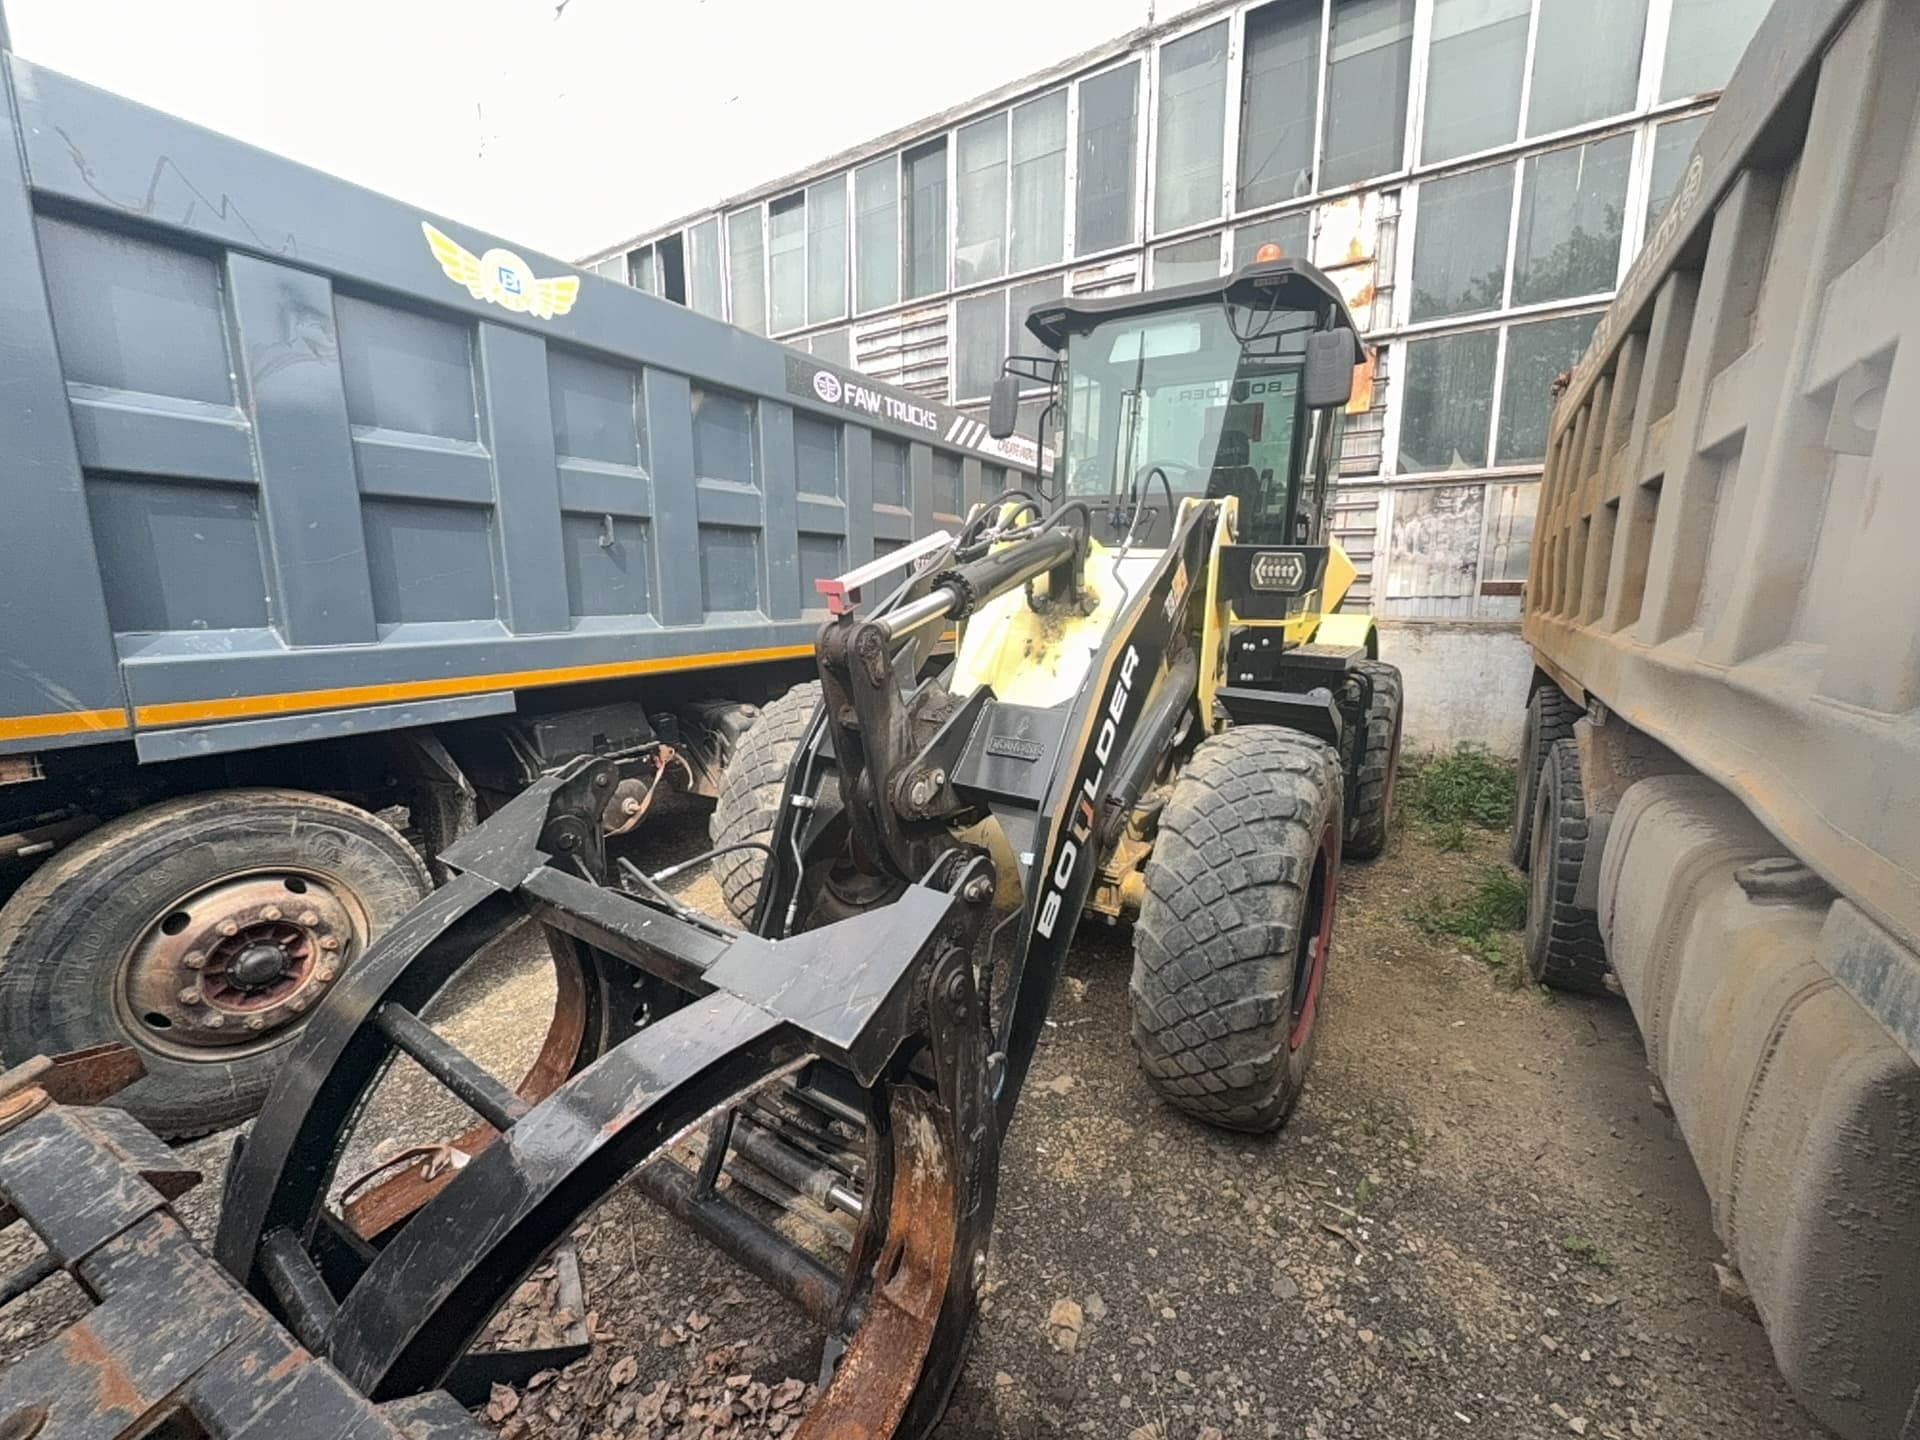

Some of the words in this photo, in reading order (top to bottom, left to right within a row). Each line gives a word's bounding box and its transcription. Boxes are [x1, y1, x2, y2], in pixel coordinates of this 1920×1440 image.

[843, 382, 881, 413] FAW
[884, 396, 937, 431] TRUCKS
[1037, 644, 1139, 939] BOULDER
